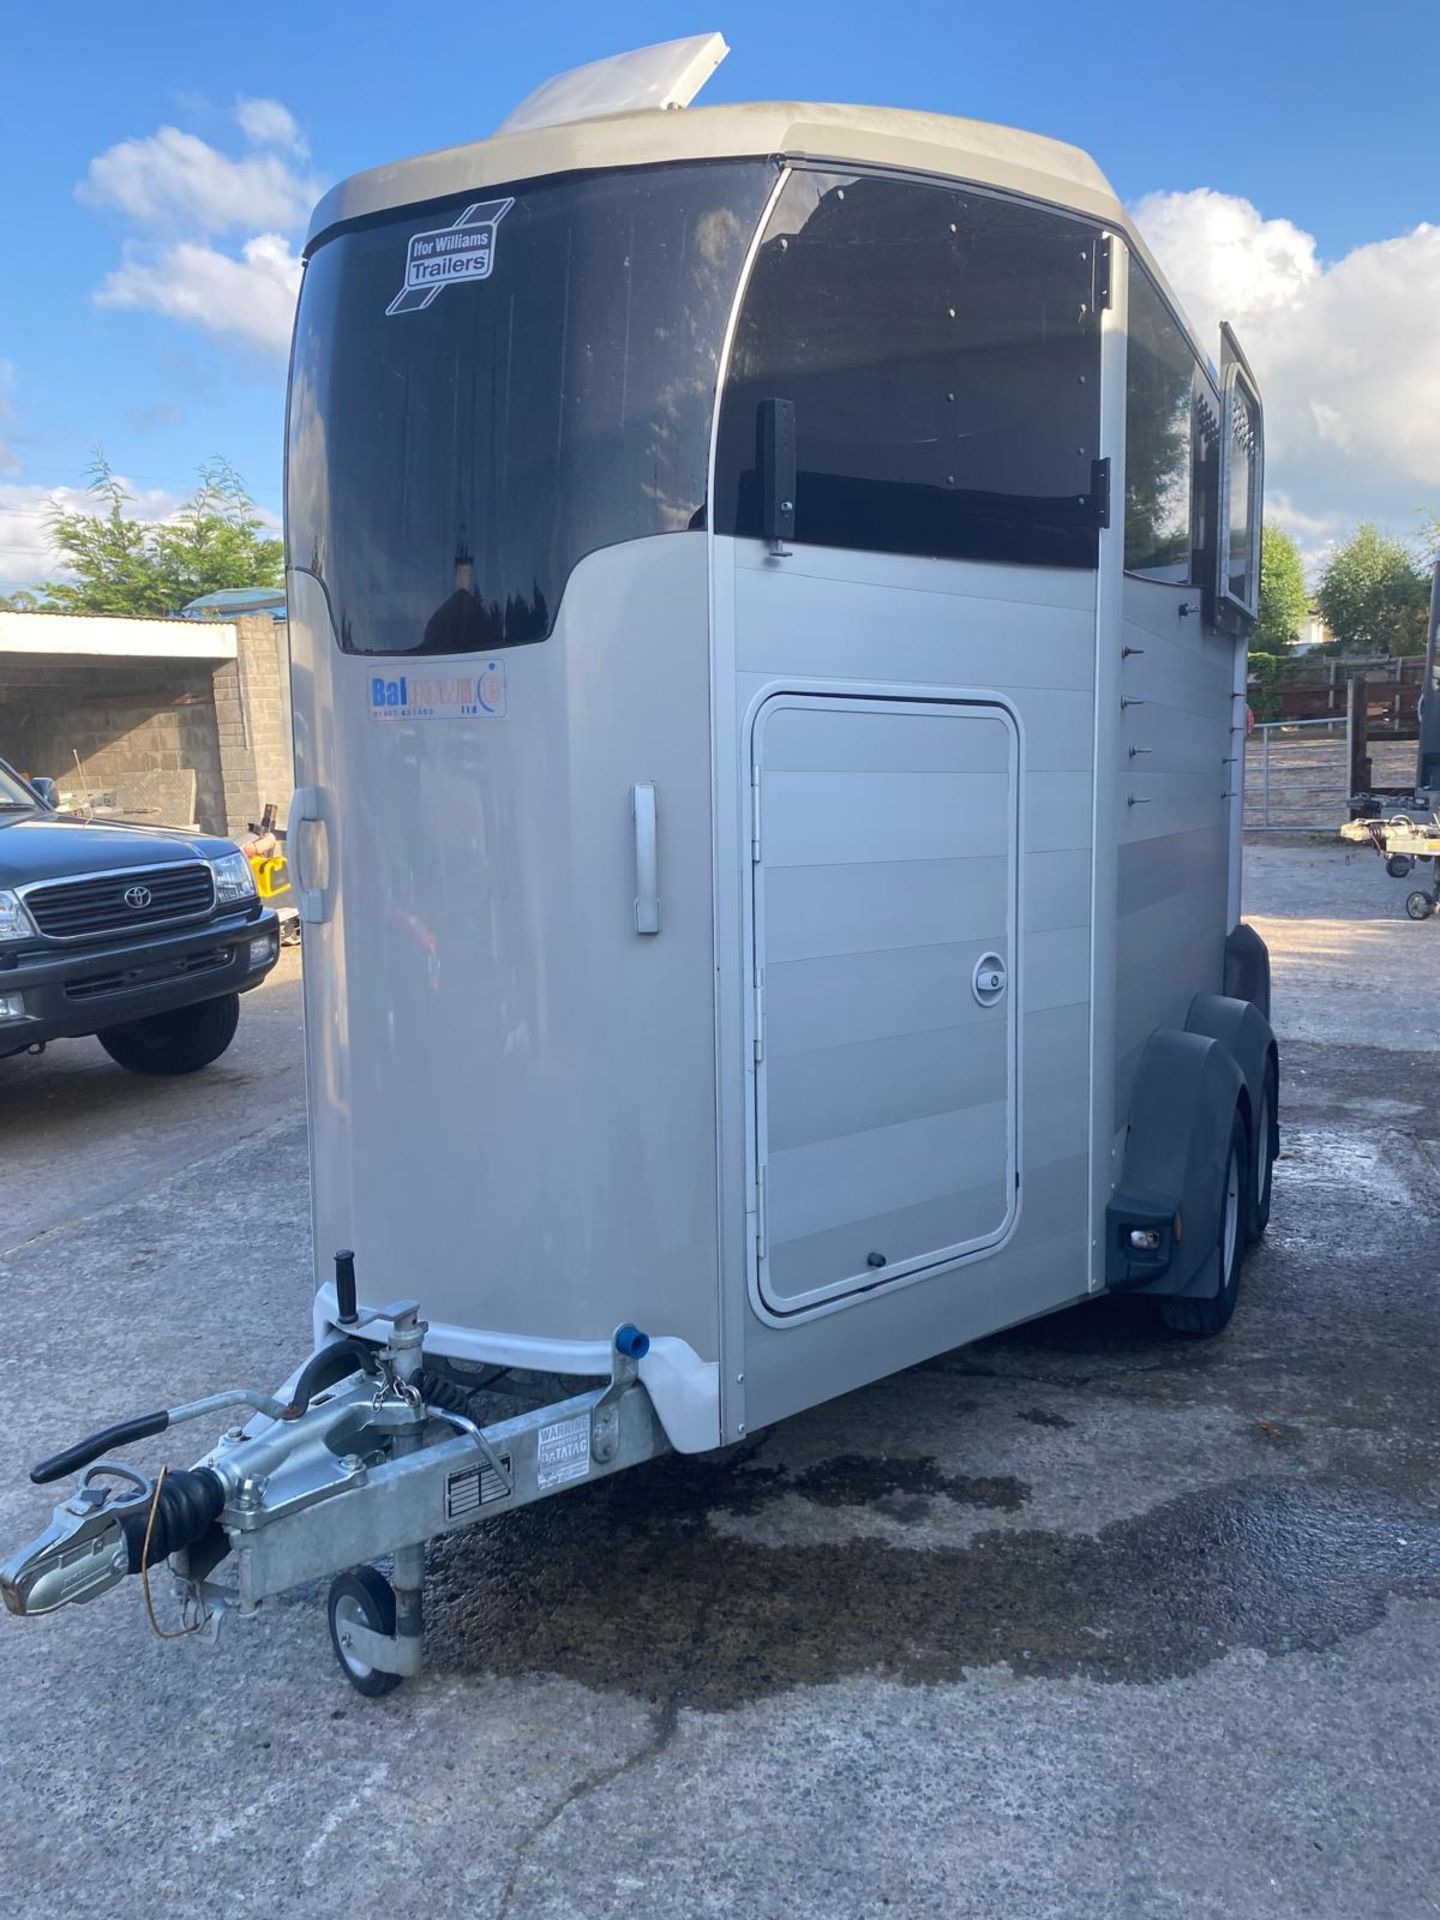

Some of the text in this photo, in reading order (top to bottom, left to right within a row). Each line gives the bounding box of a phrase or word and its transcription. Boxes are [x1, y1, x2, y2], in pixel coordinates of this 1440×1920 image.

[414, 233, 489, 257] Ifor Williams
[412, 256, 486, 280] Trailers
[541, 1416, 588, 1442] WARNING
[541, 1440, 587, 1463] DATATAG
